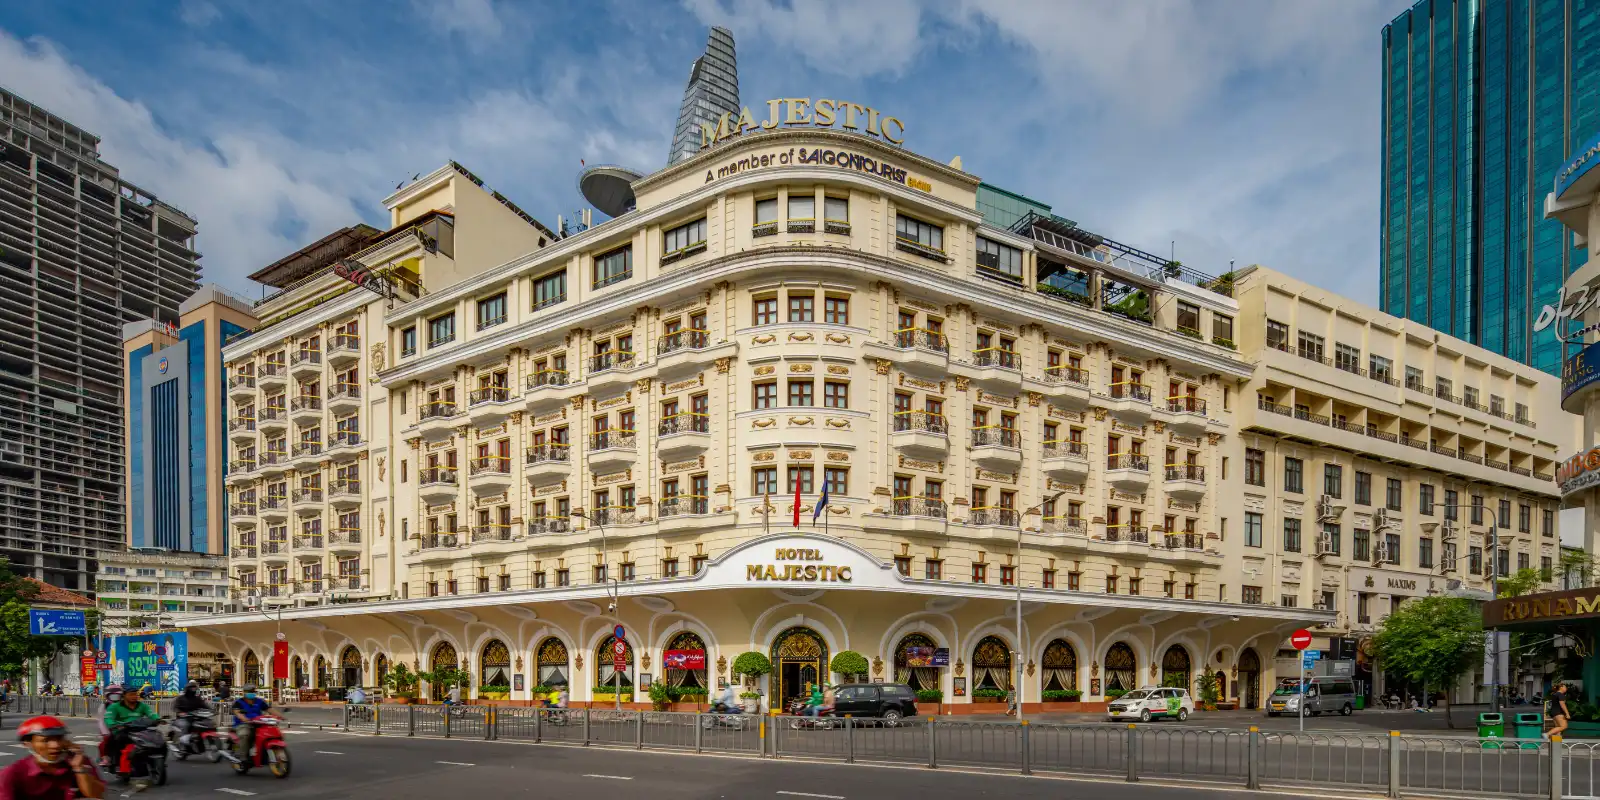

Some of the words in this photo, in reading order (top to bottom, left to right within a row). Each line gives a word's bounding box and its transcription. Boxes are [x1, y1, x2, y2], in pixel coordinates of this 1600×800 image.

[700, 96, 905, 149] MAJESTIC
[705, 169, 715, 184] A
[717, 153, 775, 179] member
[779, 148, 795, 165] of
[797, 147, 908, 185] SAIGONTOURIST
[775, 547, 824, 561] HOTEL
[746, 564, 852, 582] MAJESTIC
[128, 656, 157, 677] SOJU
